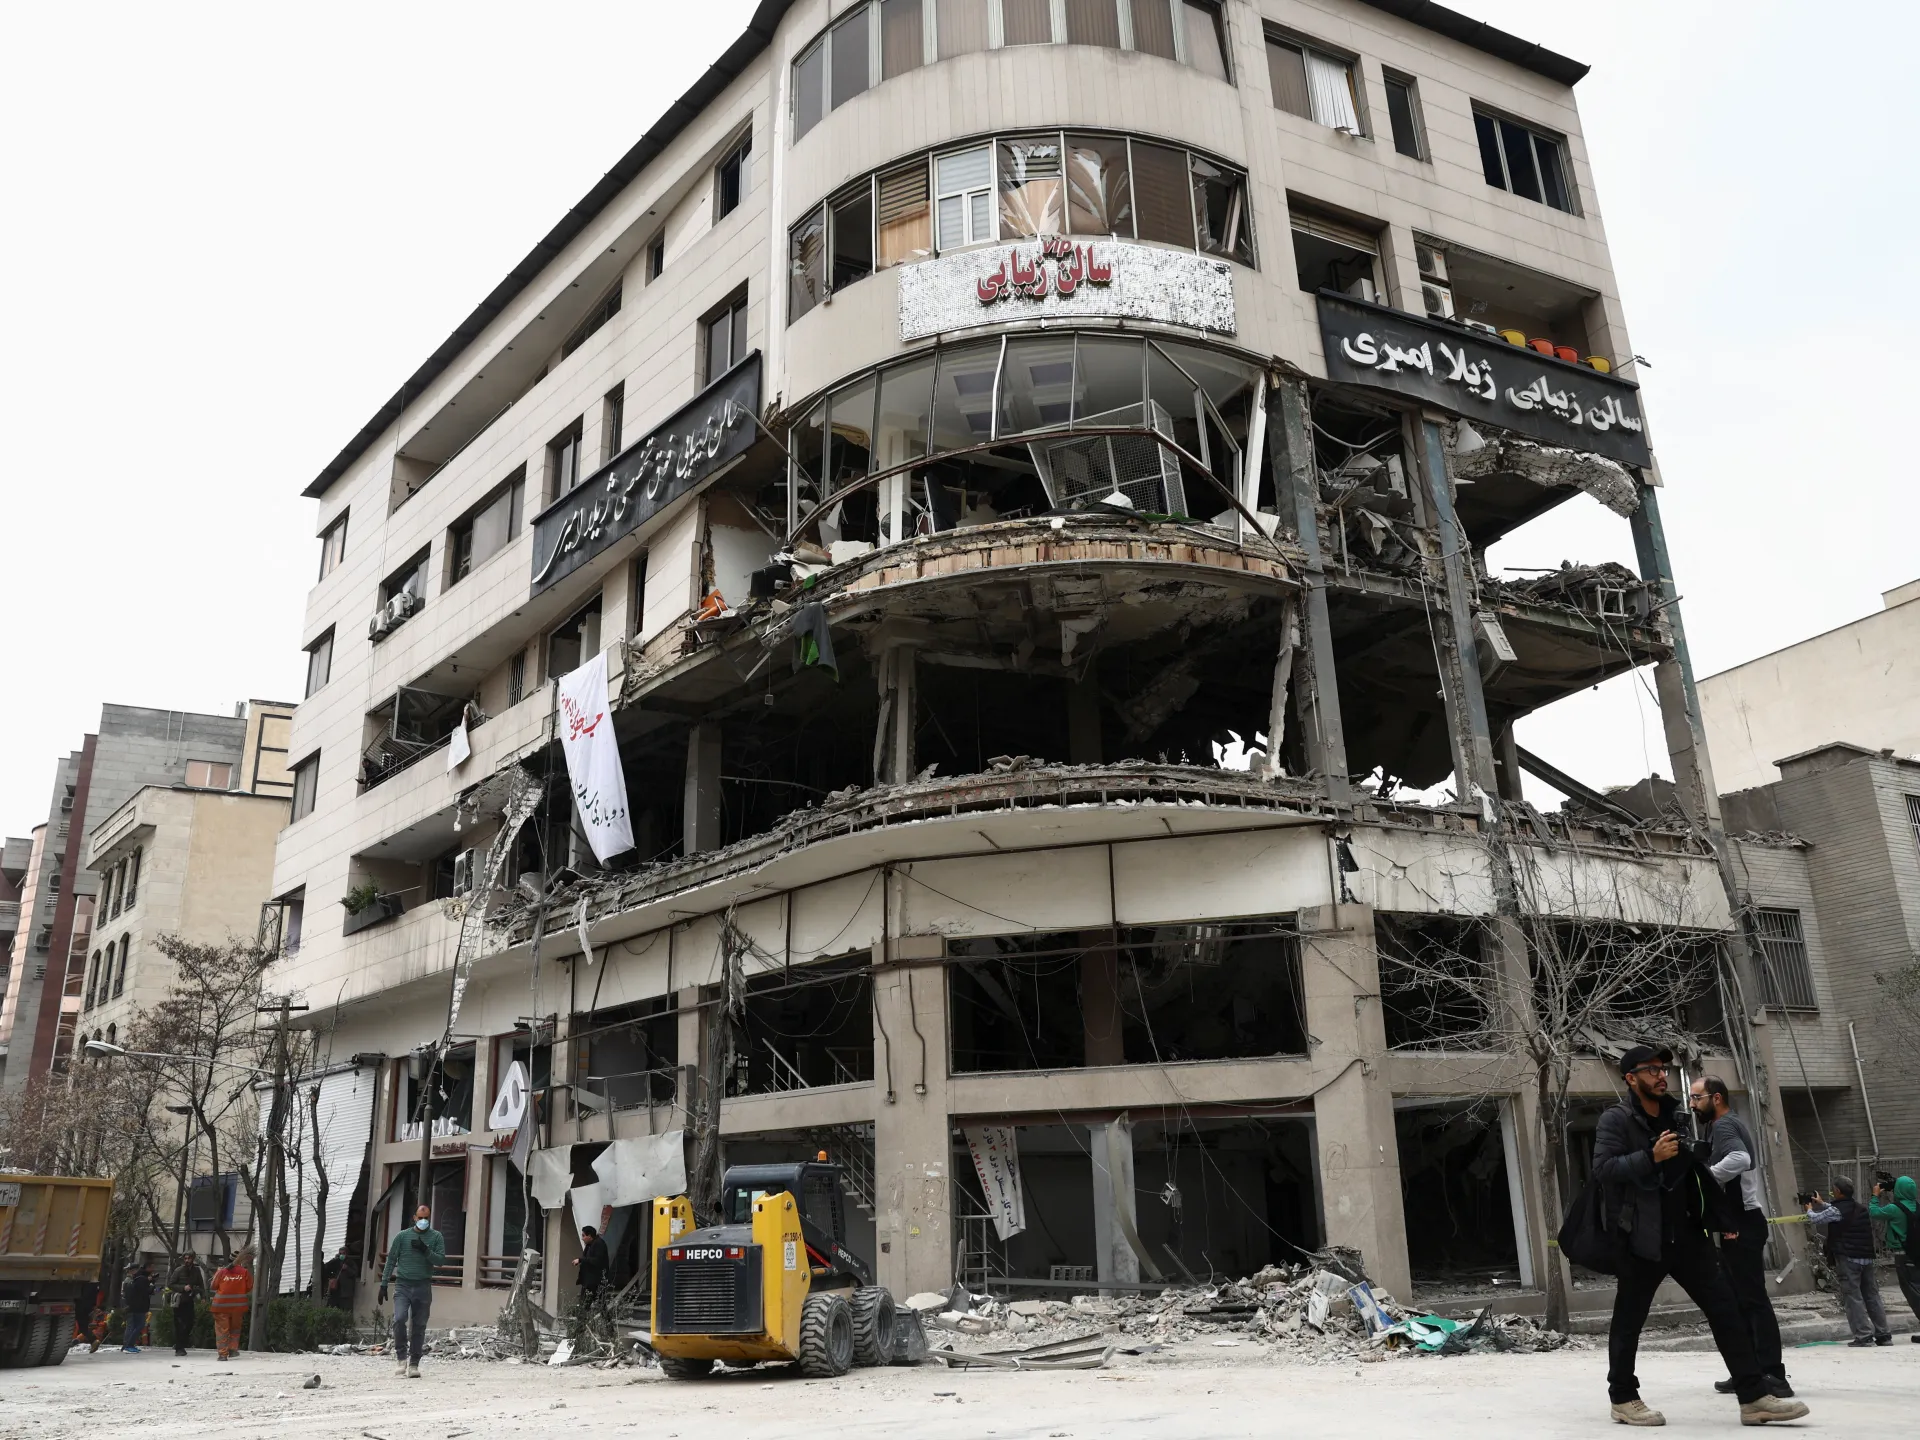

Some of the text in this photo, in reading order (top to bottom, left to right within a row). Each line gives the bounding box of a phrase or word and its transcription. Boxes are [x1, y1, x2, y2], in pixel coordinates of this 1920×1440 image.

[976, 245, 1112, 301] سالن زیبایی
[1042, 236, 1072, 255] vip
[1341, 331, 1642, 432] سالن زیبایی ژیلا امیری
[707, 398, 745, 459] سالن
[584, 472, 619, 541] ژیلا
[531, 507, 587, 584] امیری
[686, 1248, 723, 1260] HEPCO
[837, 1247, 852, 1264] HEPCO
